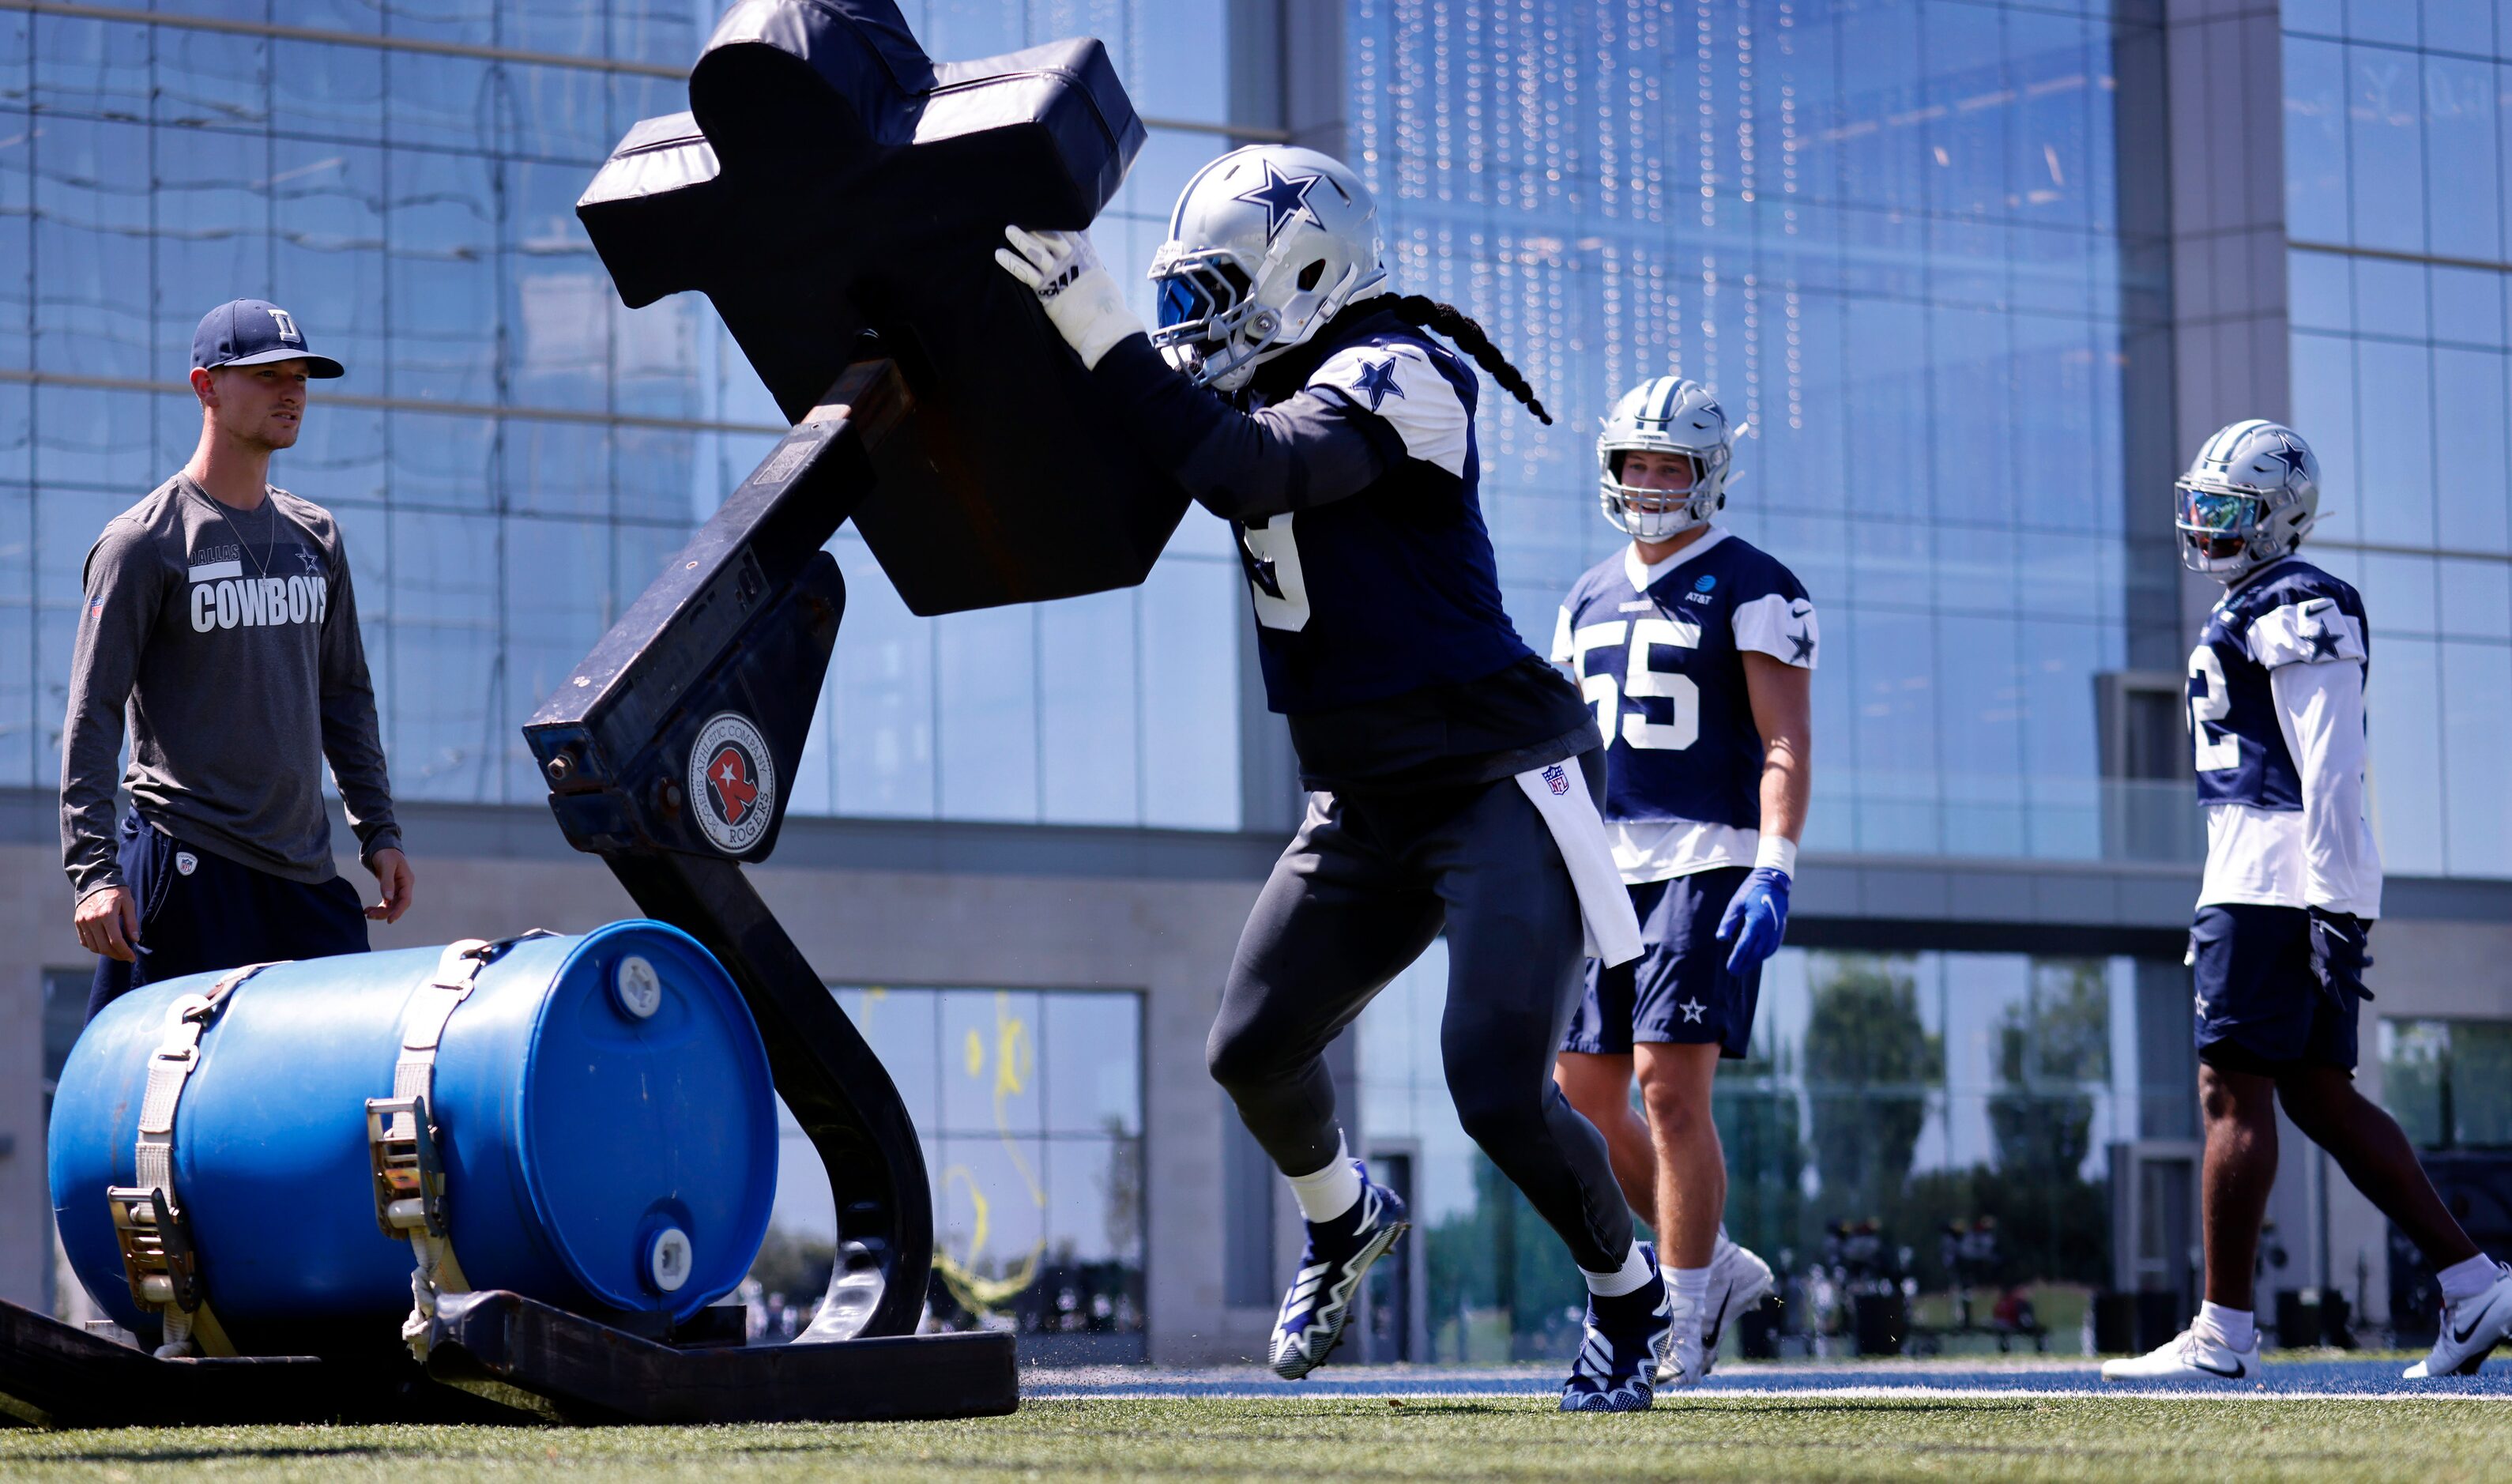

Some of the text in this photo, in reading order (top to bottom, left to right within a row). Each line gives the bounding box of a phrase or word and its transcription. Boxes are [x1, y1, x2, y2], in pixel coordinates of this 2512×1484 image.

[267, 309, 301, 343] D
[187, 544, 240, 567] DALLAS
[190, 575, 326, 633] COWBOYS
[1685, 592, 1713, 605] AT&T
[1573, 619, 1701, 751] 55
[696, 725, 767, 833] ROGERS ATHLETIC COMPANY
[1549, 776, 1568, 793] NFL
[729, 791, 769, 843] ROGERS
